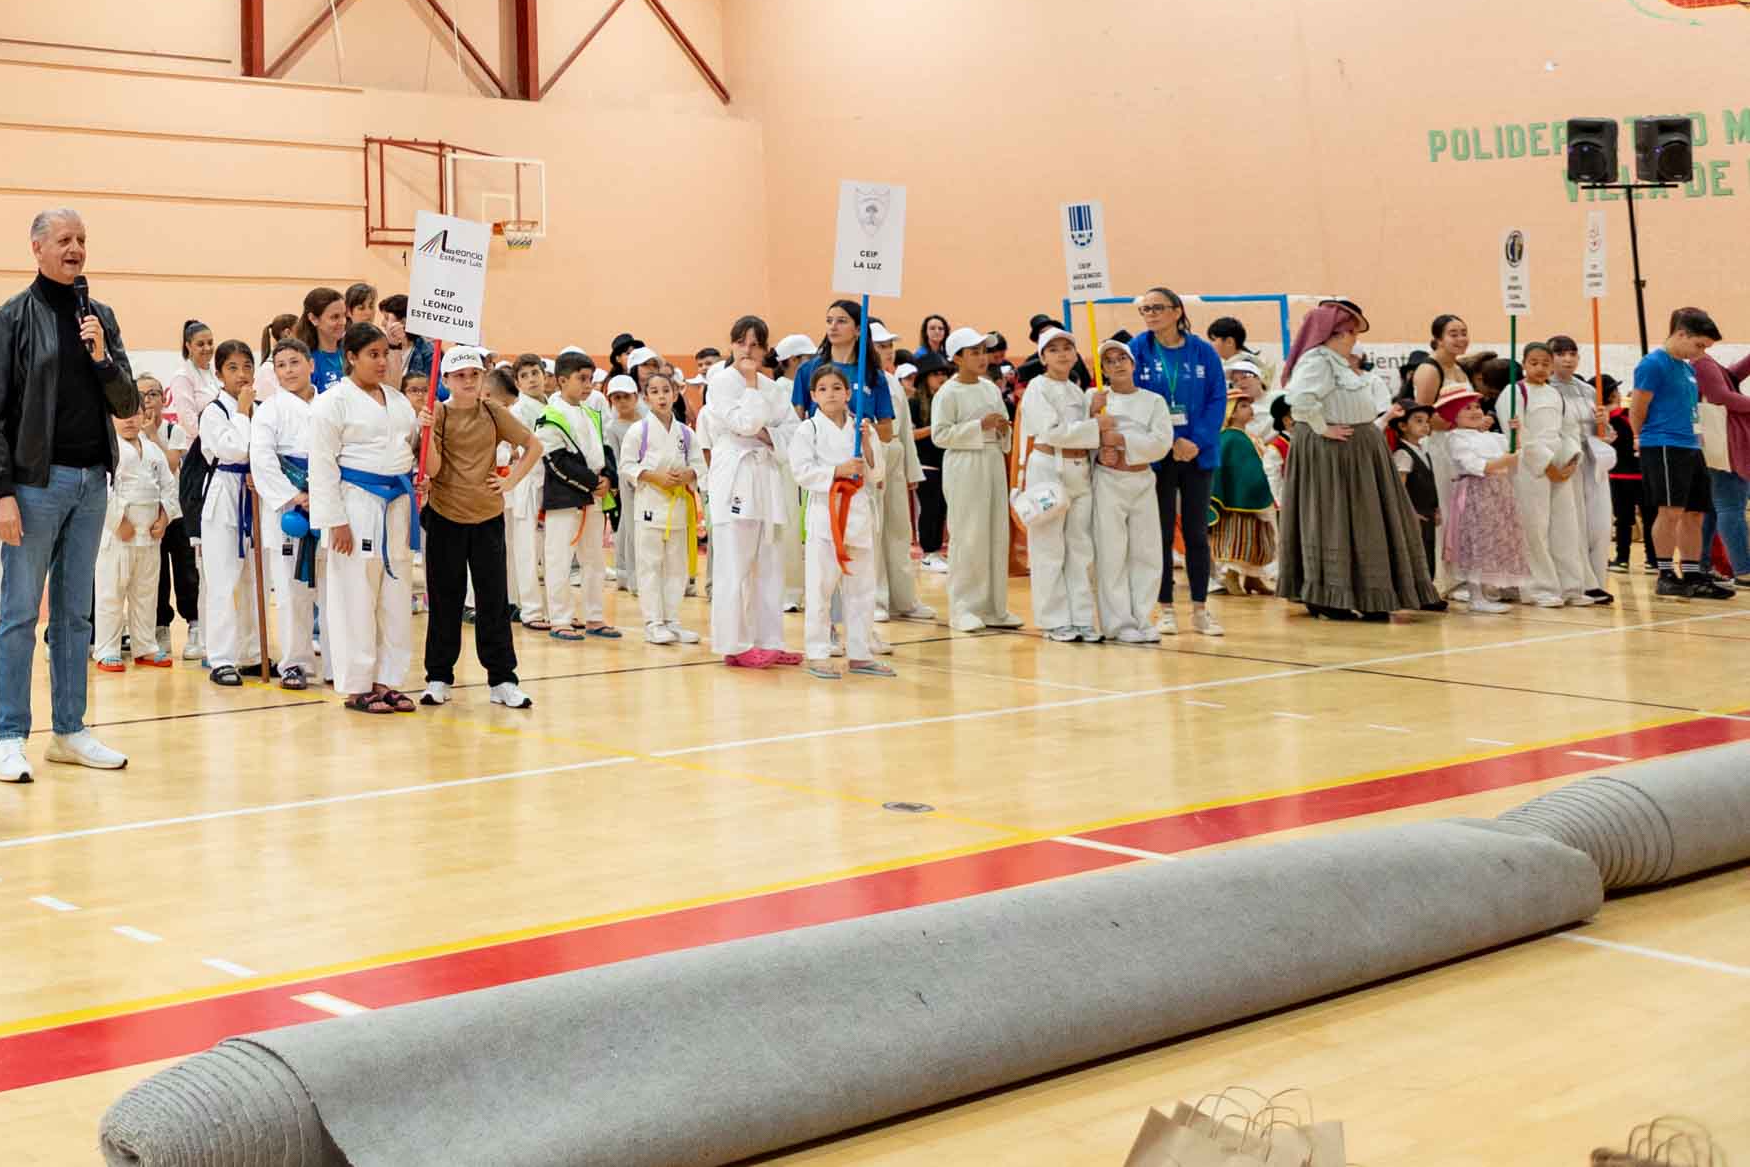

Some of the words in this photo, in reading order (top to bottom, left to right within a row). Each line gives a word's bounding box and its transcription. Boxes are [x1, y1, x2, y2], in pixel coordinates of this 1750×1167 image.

[860, 250, 878, 258] CEIP
[866, 262, 882, 270] LUZ
[434, 288, 455, 298] CEIP
[423, 299, 464, 313] LEONCIO
[453, 317, 474, 329] LUIS
